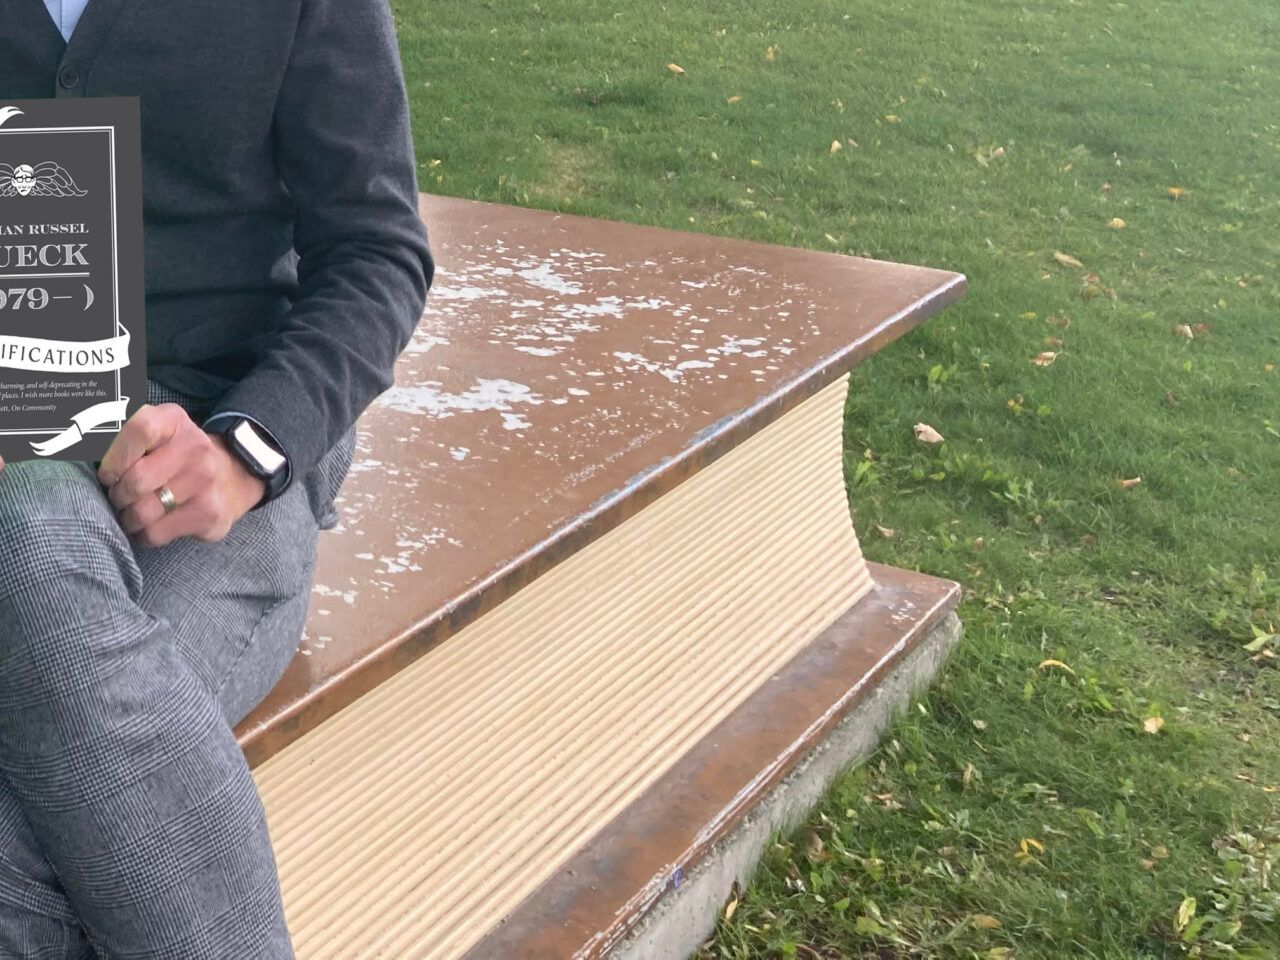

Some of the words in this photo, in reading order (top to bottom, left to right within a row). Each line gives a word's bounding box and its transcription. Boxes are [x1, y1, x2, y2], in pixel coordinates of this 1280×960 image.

[29, 223, 89, 235] RUSSEL
[26, 381, 38, 389] and
[39, 380, 81, 390] self-deprecating
[1, 392, 19, 401] places.
[96, 389, 107, 397] this.
[22, 404, 57, 412] Community
